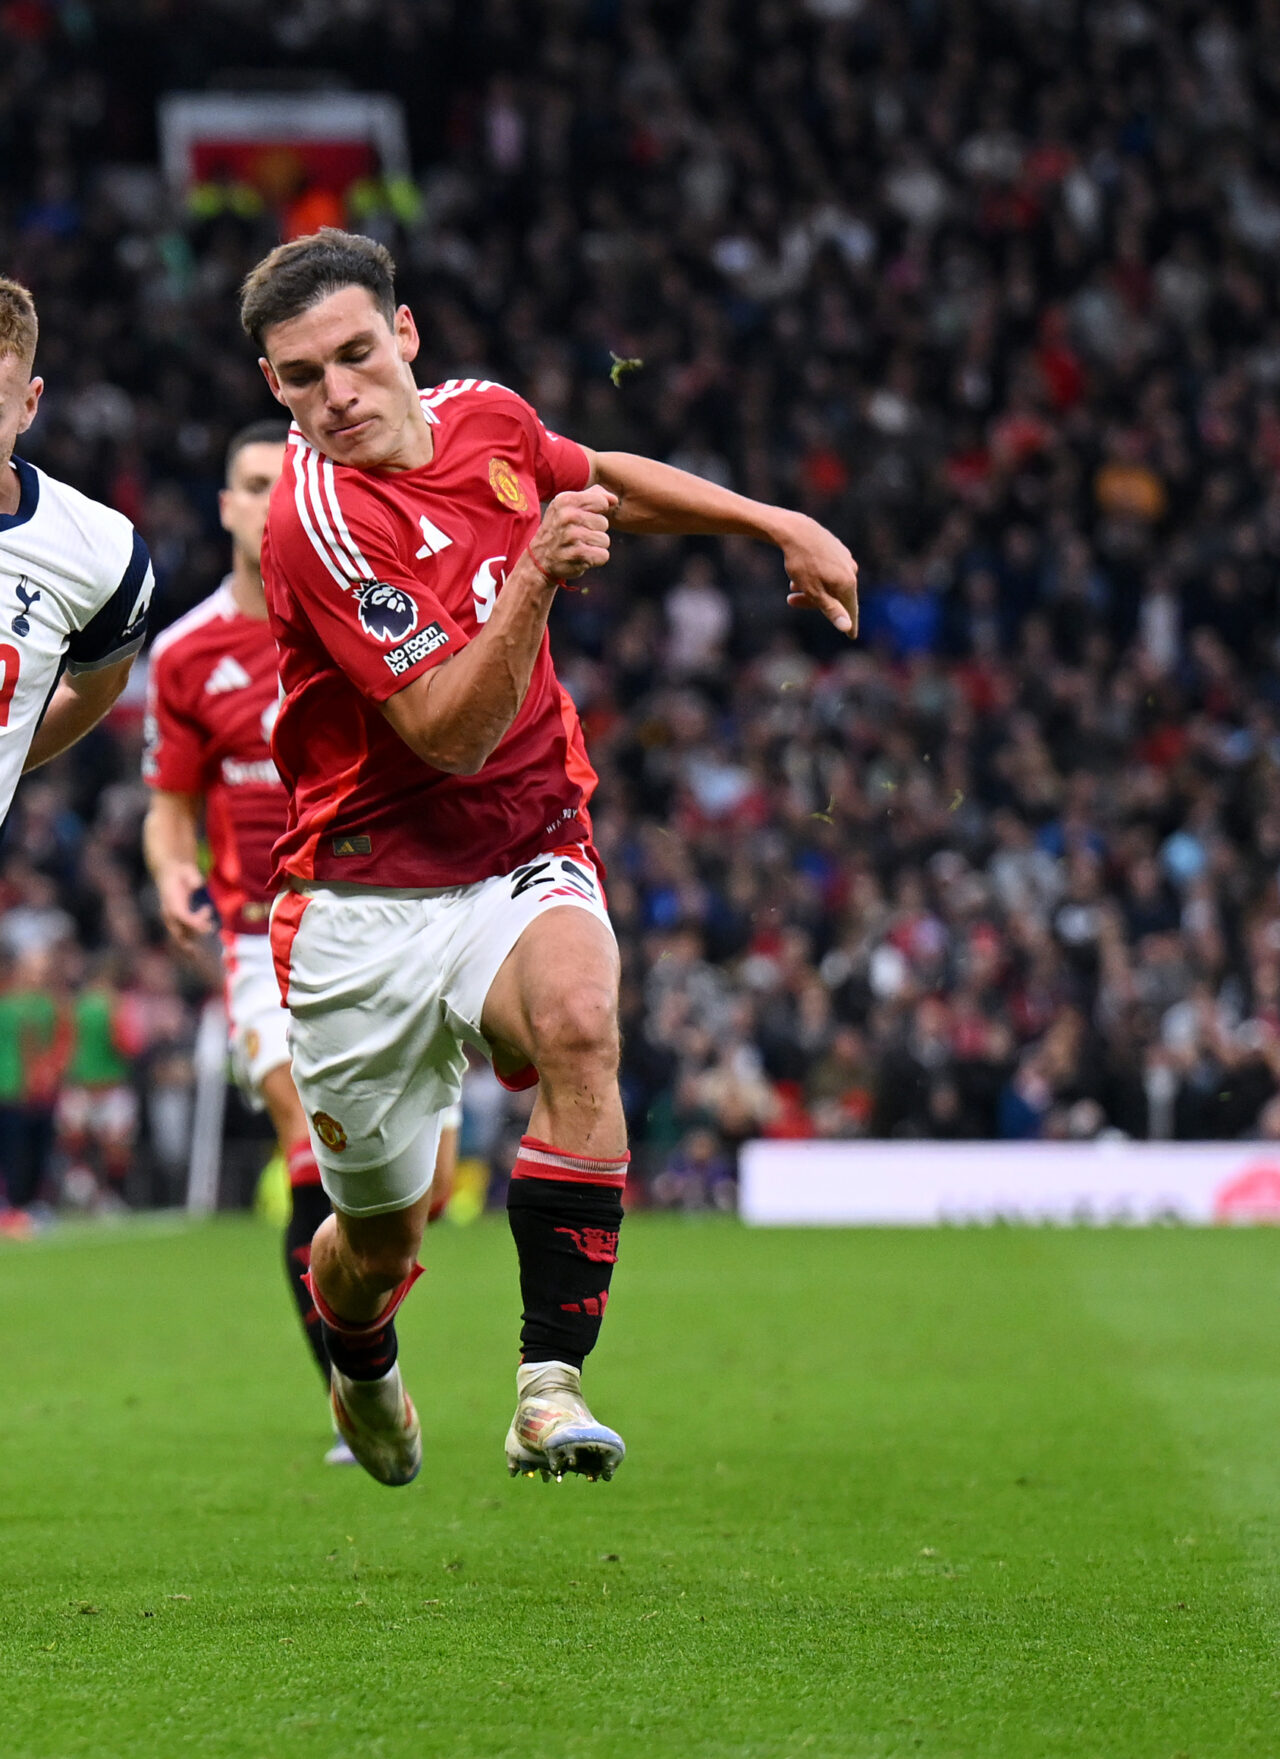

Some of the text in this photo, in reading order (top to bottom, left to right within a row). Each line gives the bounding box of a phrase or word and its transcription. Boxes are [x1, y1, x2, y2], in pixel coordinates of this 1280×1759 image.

[383, 626, 438, 666] No room
[390, 632, 450, 677] for racism
